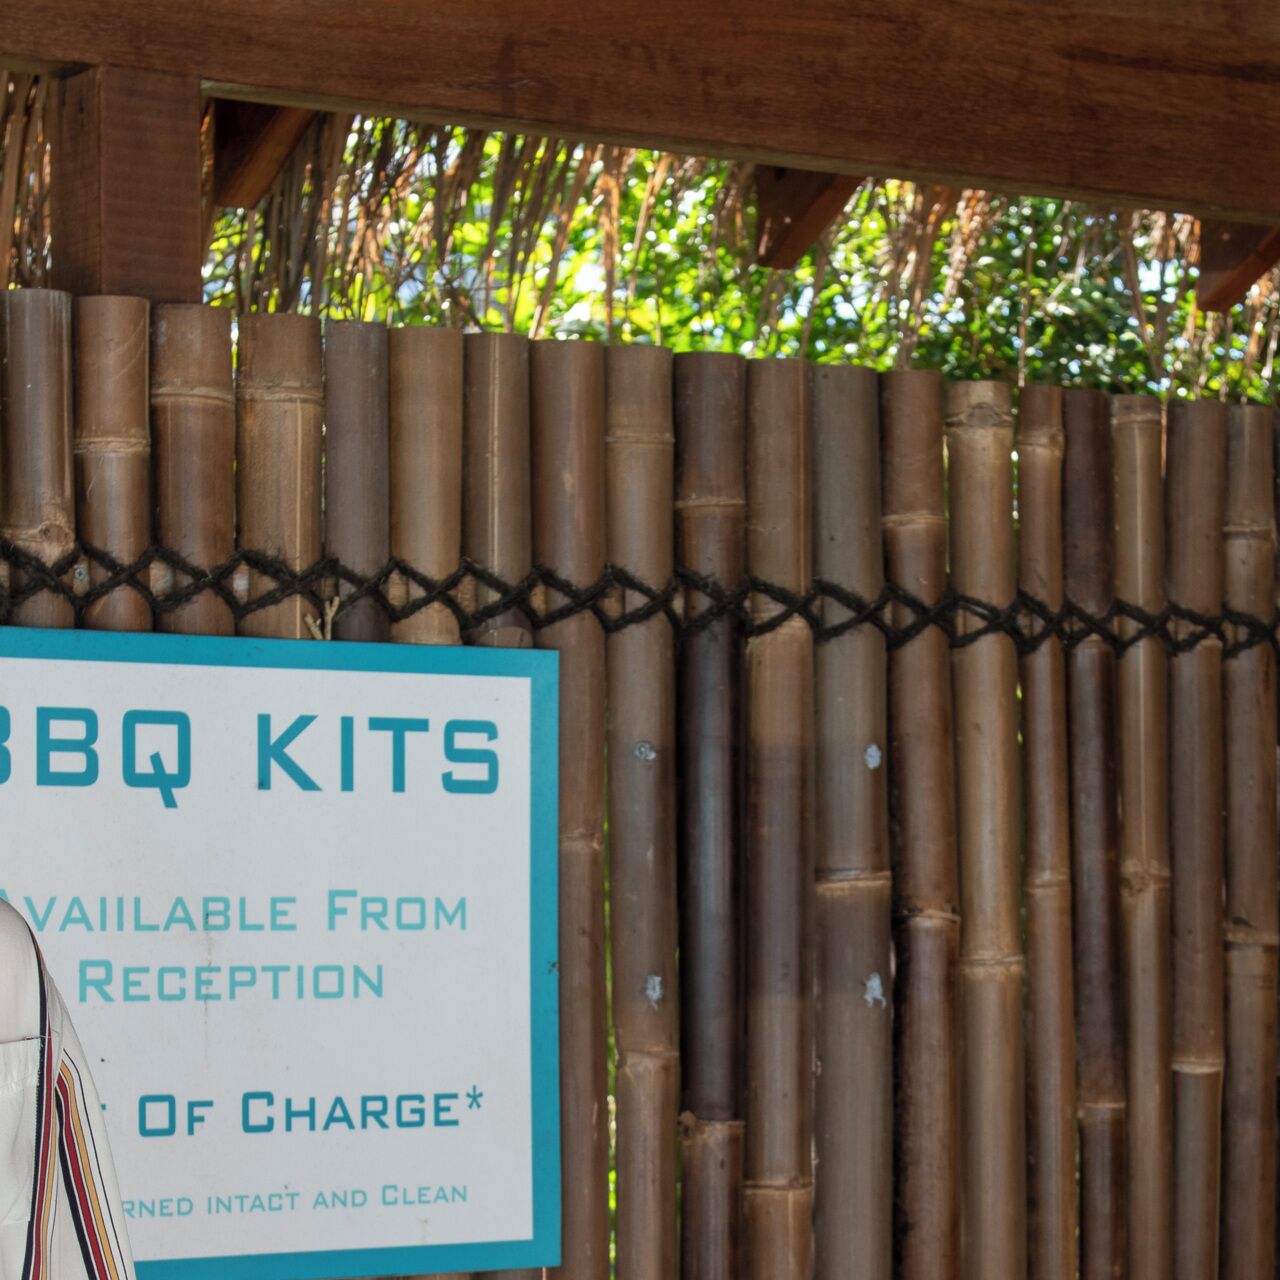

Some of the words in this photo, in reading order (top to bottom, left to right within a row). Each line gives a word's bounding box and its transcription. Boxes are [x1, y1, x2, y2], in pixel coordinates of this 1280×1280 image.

[257, 713, 500, 794] KITS
[327, 889, 468, 932] FROM
[79, 960, 385, 1004] RECEPTION
[138, 1094, 215, 1138] OF
[207, 1191, 300, 1216] INTACT
[312, 1189, 369, 1211] AND
[379, 1184, 469, 1208] CLEAN
